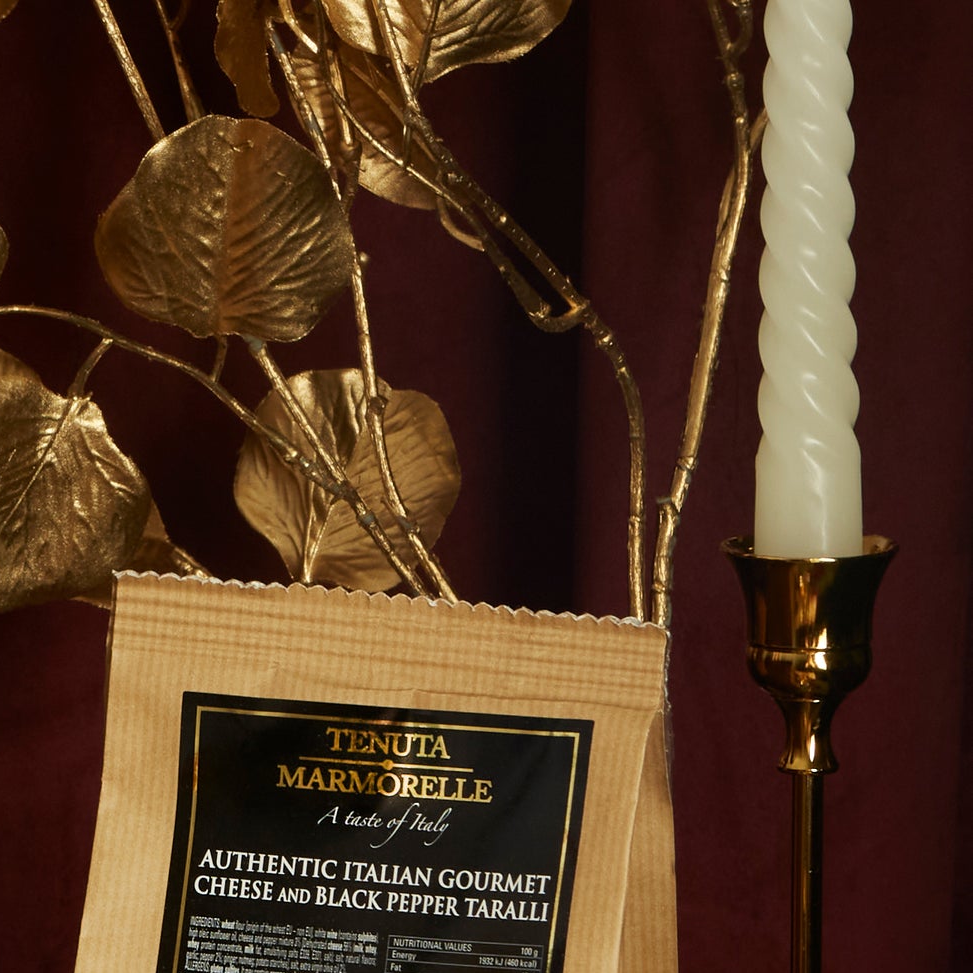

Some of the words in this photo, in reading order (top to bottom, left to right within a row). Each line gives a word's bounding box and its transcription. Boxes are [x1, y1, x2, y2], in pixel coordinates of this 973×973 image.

[326, 727, 451, 760] TENUTA
[276, 764, 493, 803] MARMORELLE
[317, 806, 339, 825] A
[344, 810, 384, 829] taste
[369, 803, 420, 849] of
[409, 807, 453, 846] Italy
[198, 849, 338, 880] AUTHENTIC
[343, 861, 433, 887] ITALIAN
[438, 868, 551, 895] GOURMET
[194, 875, 274, 901] CHEESE
[277, 887, 311, 904] AND
[315, 885, 382, 910] BLACK
[386, 891, 460, 917] PEPPER
[464, 898, 550, 922] TARALLI
[391, 950, 417, 961] Energy
[393, 938, 443, 950] NUTRITIONAL
[444, 942, 473, 952] VALUES
[521, 947, 533, 956] 100
[390, 962, 402, 972] Fat
